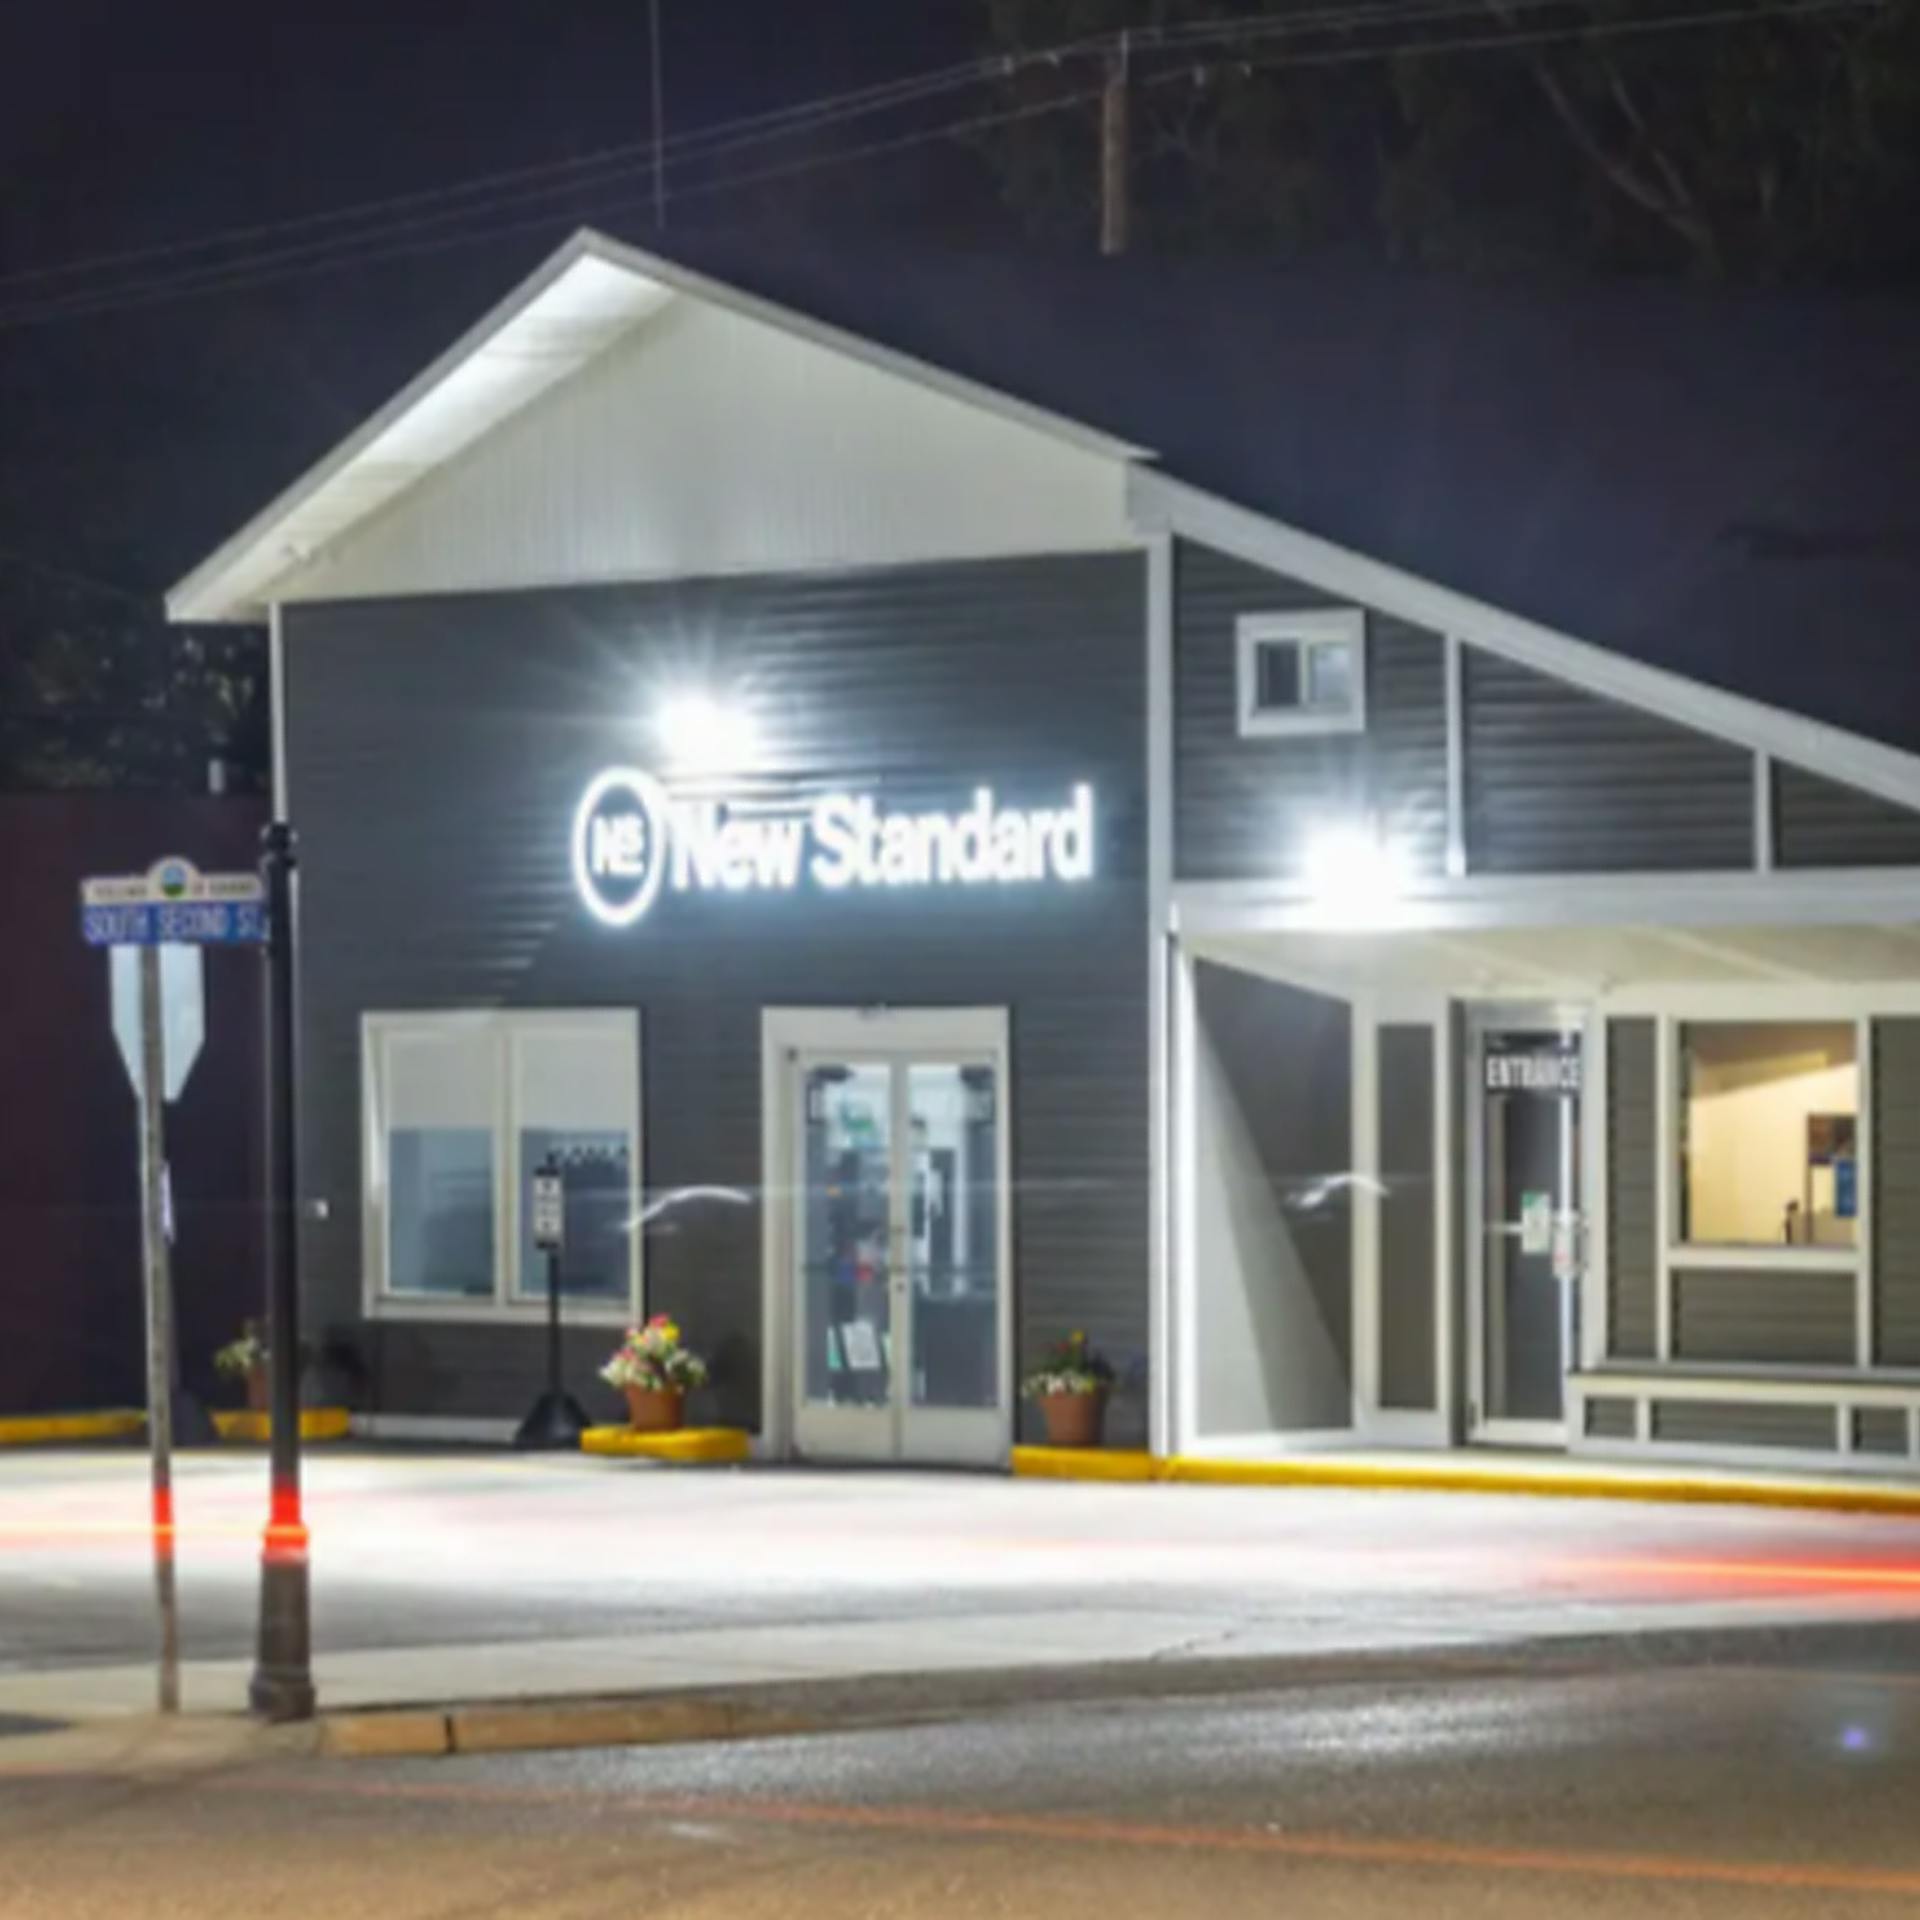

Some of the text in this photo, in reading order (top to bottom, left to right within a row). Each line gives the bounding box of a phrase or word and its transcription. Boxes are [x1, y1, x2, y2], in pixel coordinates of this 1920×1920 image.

[667, 785, 1092, 889] New Standard
[1487, 1055, 1580, 1088] ENTRANCE
